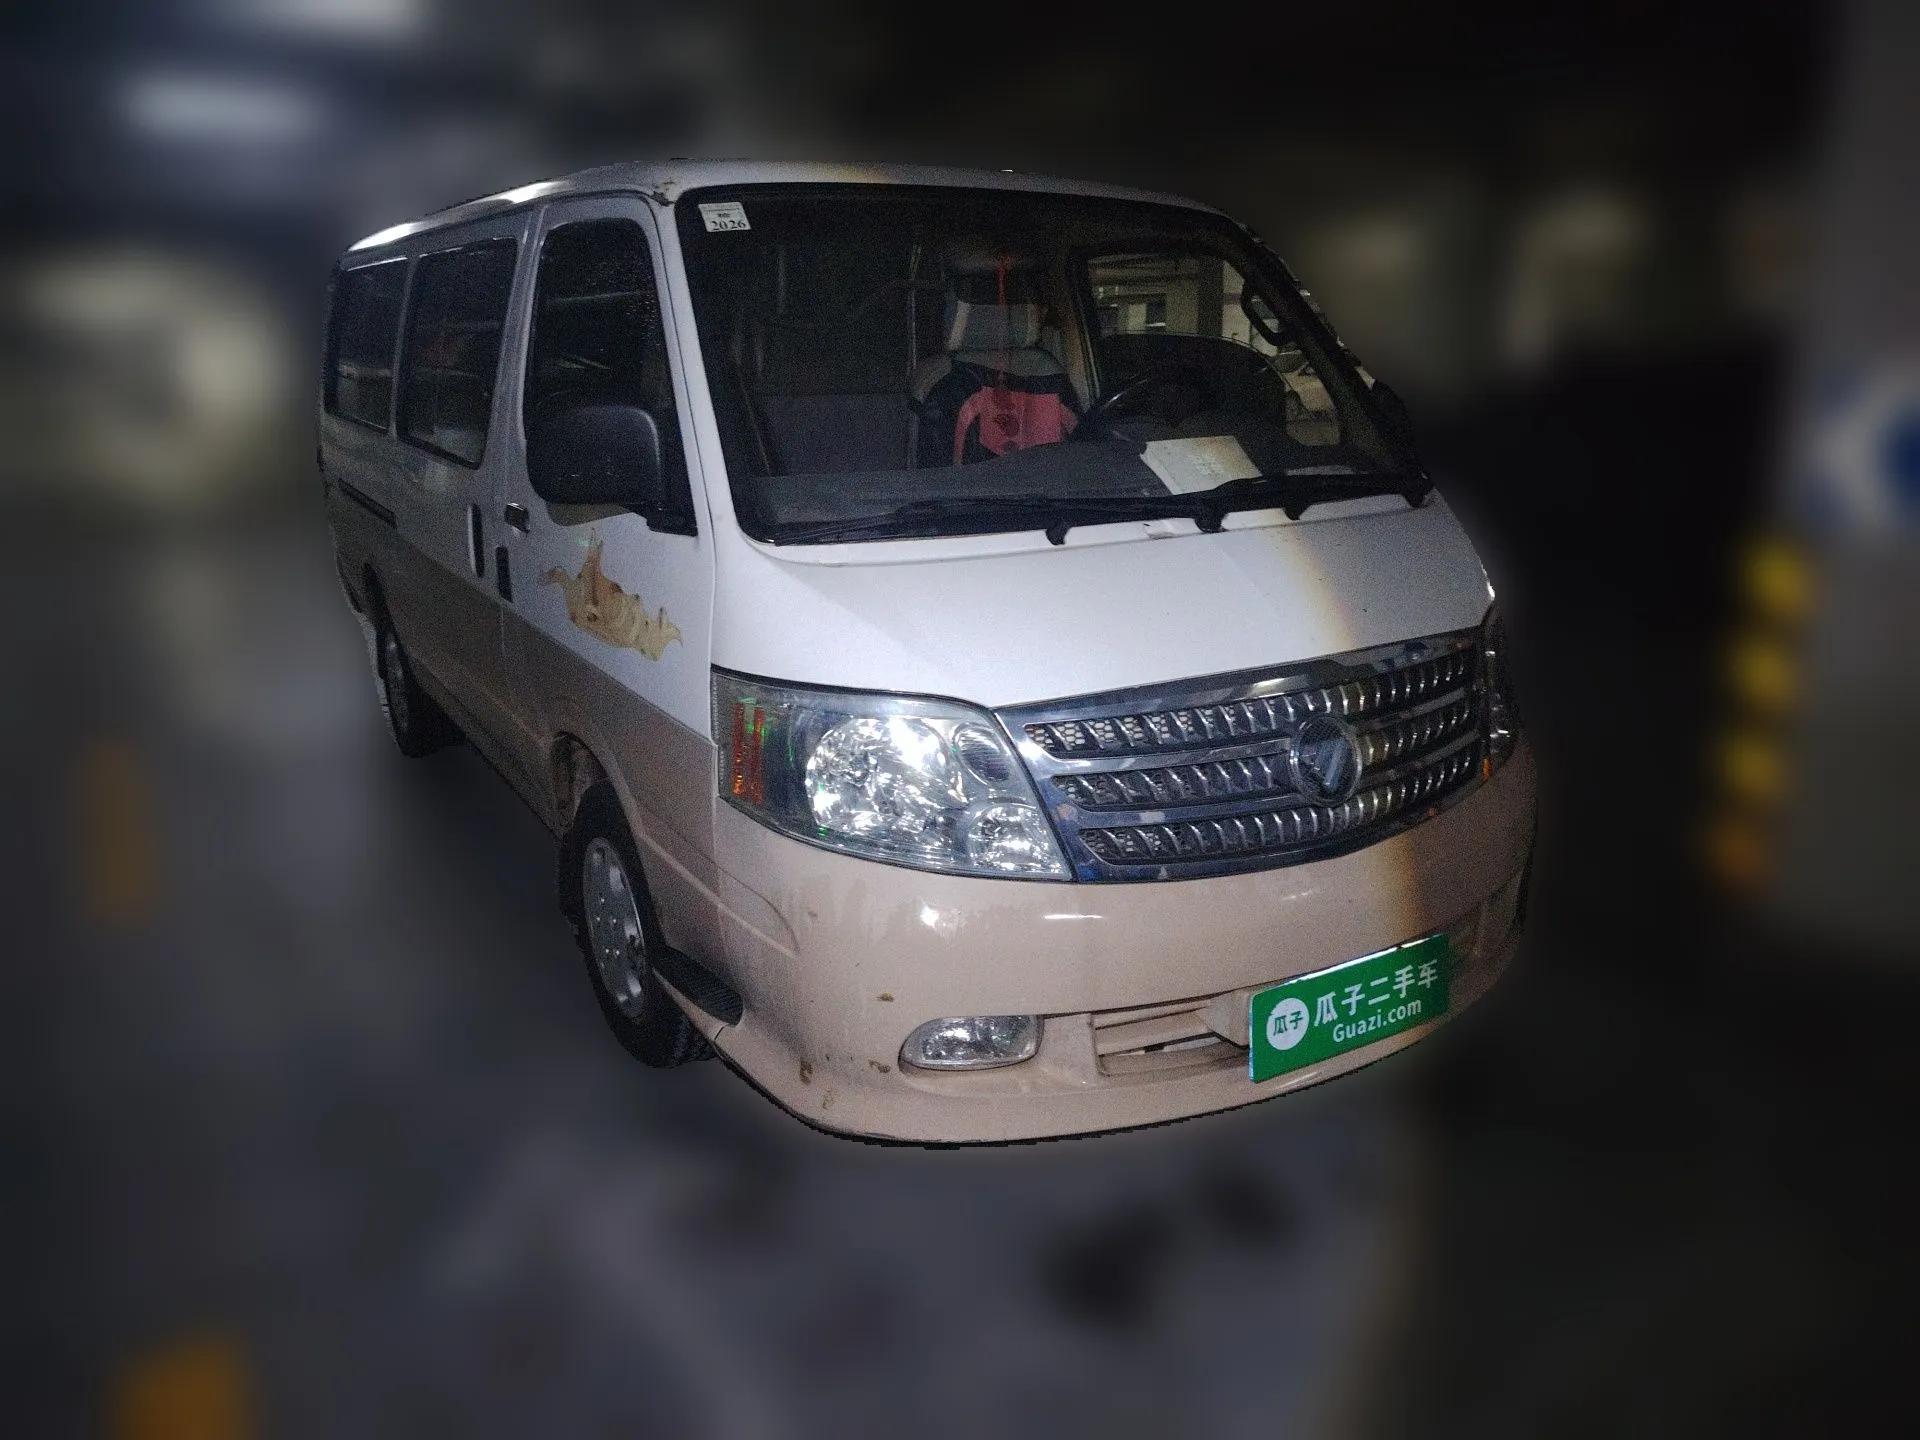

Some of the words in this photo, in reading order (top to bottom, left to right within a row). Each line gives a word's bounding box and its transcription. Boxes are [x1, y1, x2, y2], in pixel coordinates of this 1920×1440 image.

[711, 220, 746, 231] 2026
[1314, 959, 1438, 1027] 瓜子二手车
[1273, 1010, 1303, 1036] 瓜子
[1333, 998, 1422, 1043] Guazi.com
